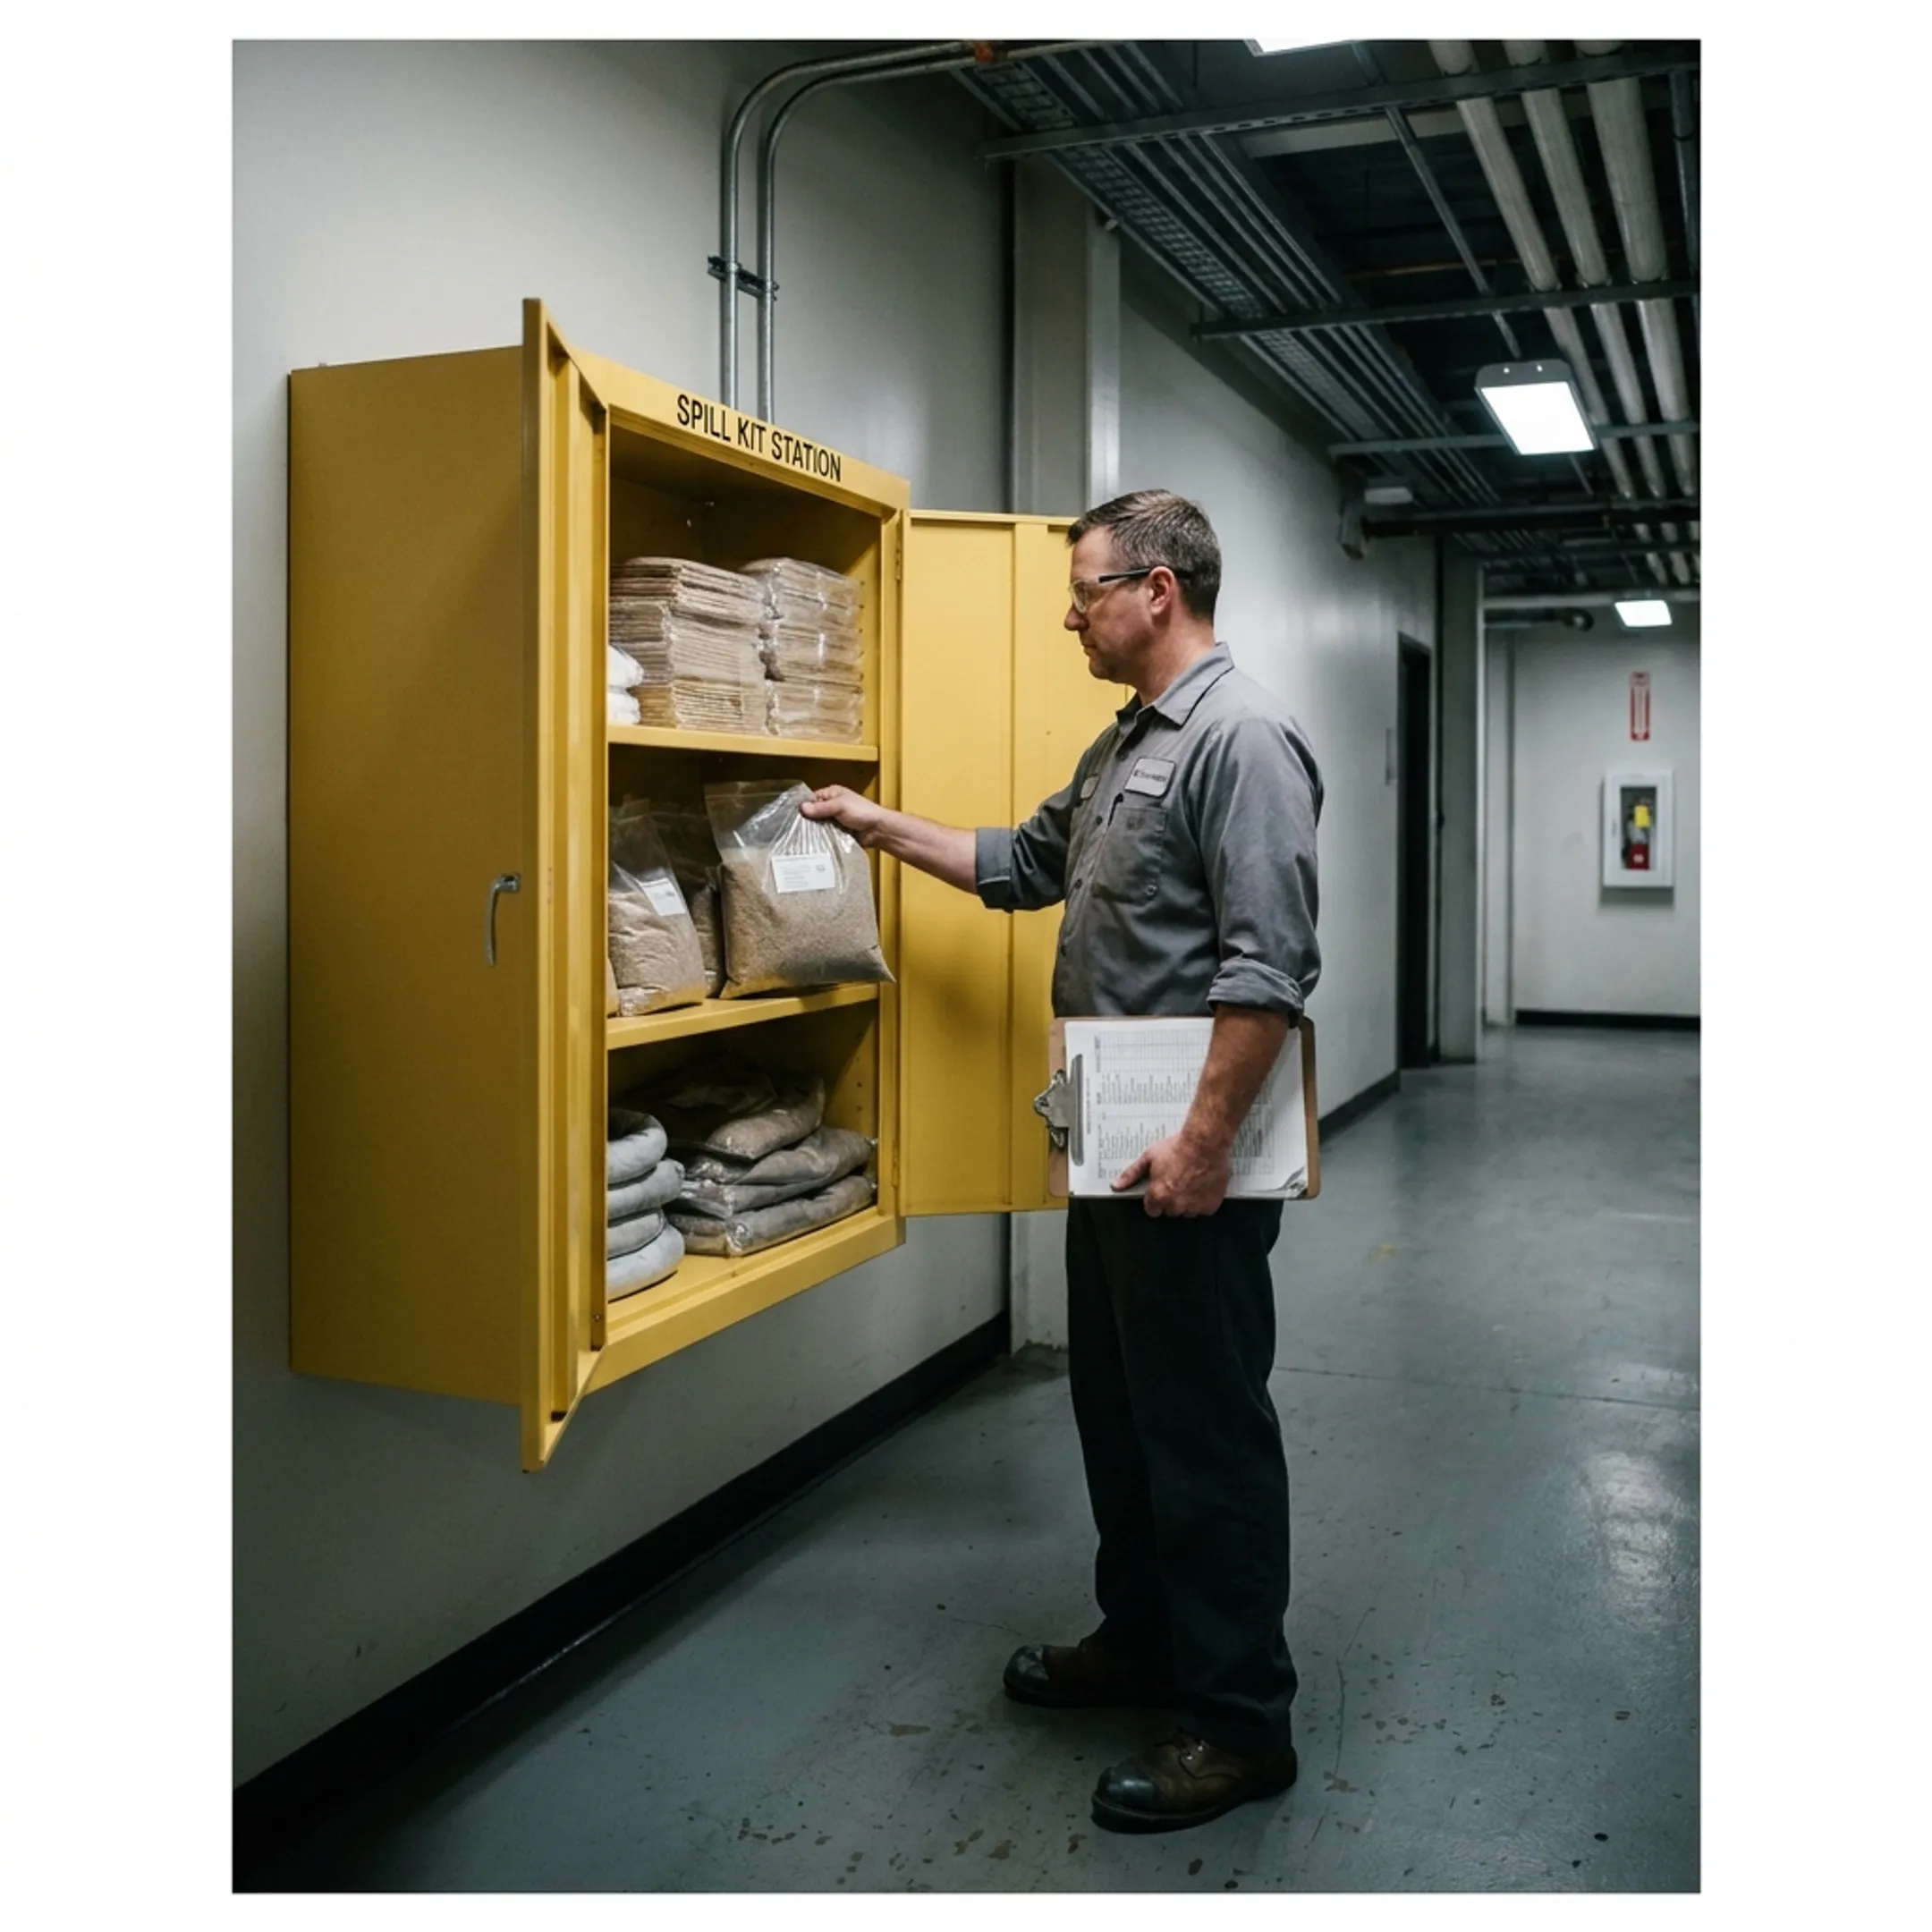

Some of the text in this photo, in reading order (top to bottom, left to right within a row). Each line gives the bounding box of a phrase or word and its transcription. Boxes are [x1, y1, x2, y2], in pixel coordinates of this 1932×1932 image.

[677, 394, 842, 482] SPILL KIT STATION
